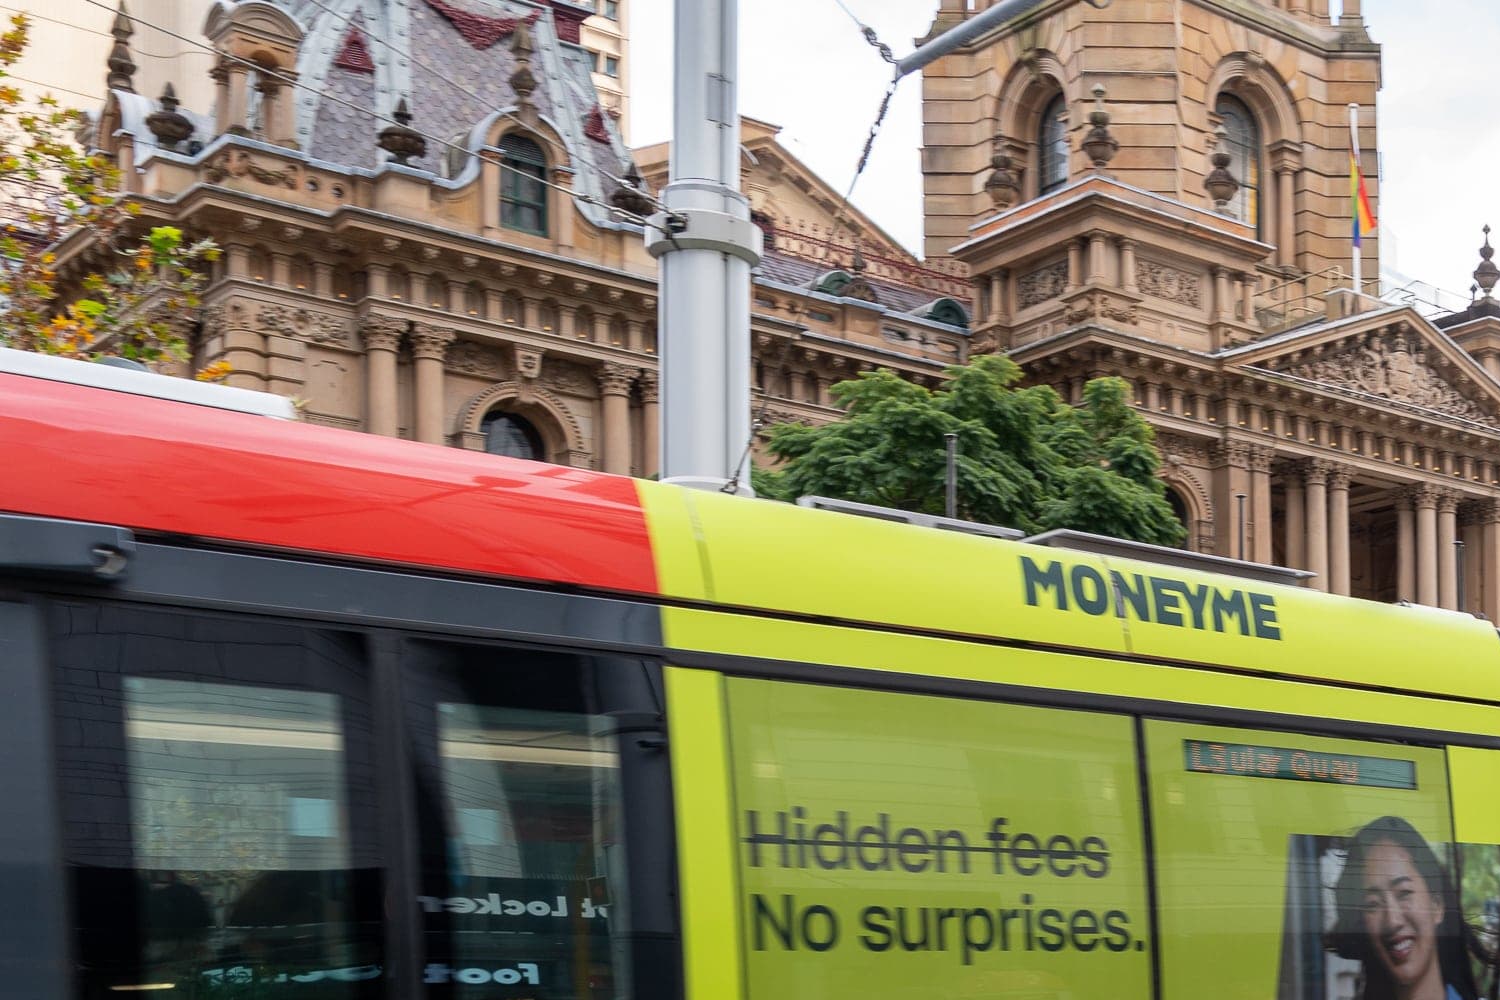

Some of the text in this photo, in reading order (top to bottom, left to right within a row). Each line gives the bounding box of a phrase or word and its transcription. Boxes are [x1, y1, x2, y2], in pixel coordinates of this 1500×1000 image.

[1019, 555, 1283, 641] MONEYME
[744, 806, 1112, 879] Hidden fees
[752, 893, 1147, 966] No surprises.
